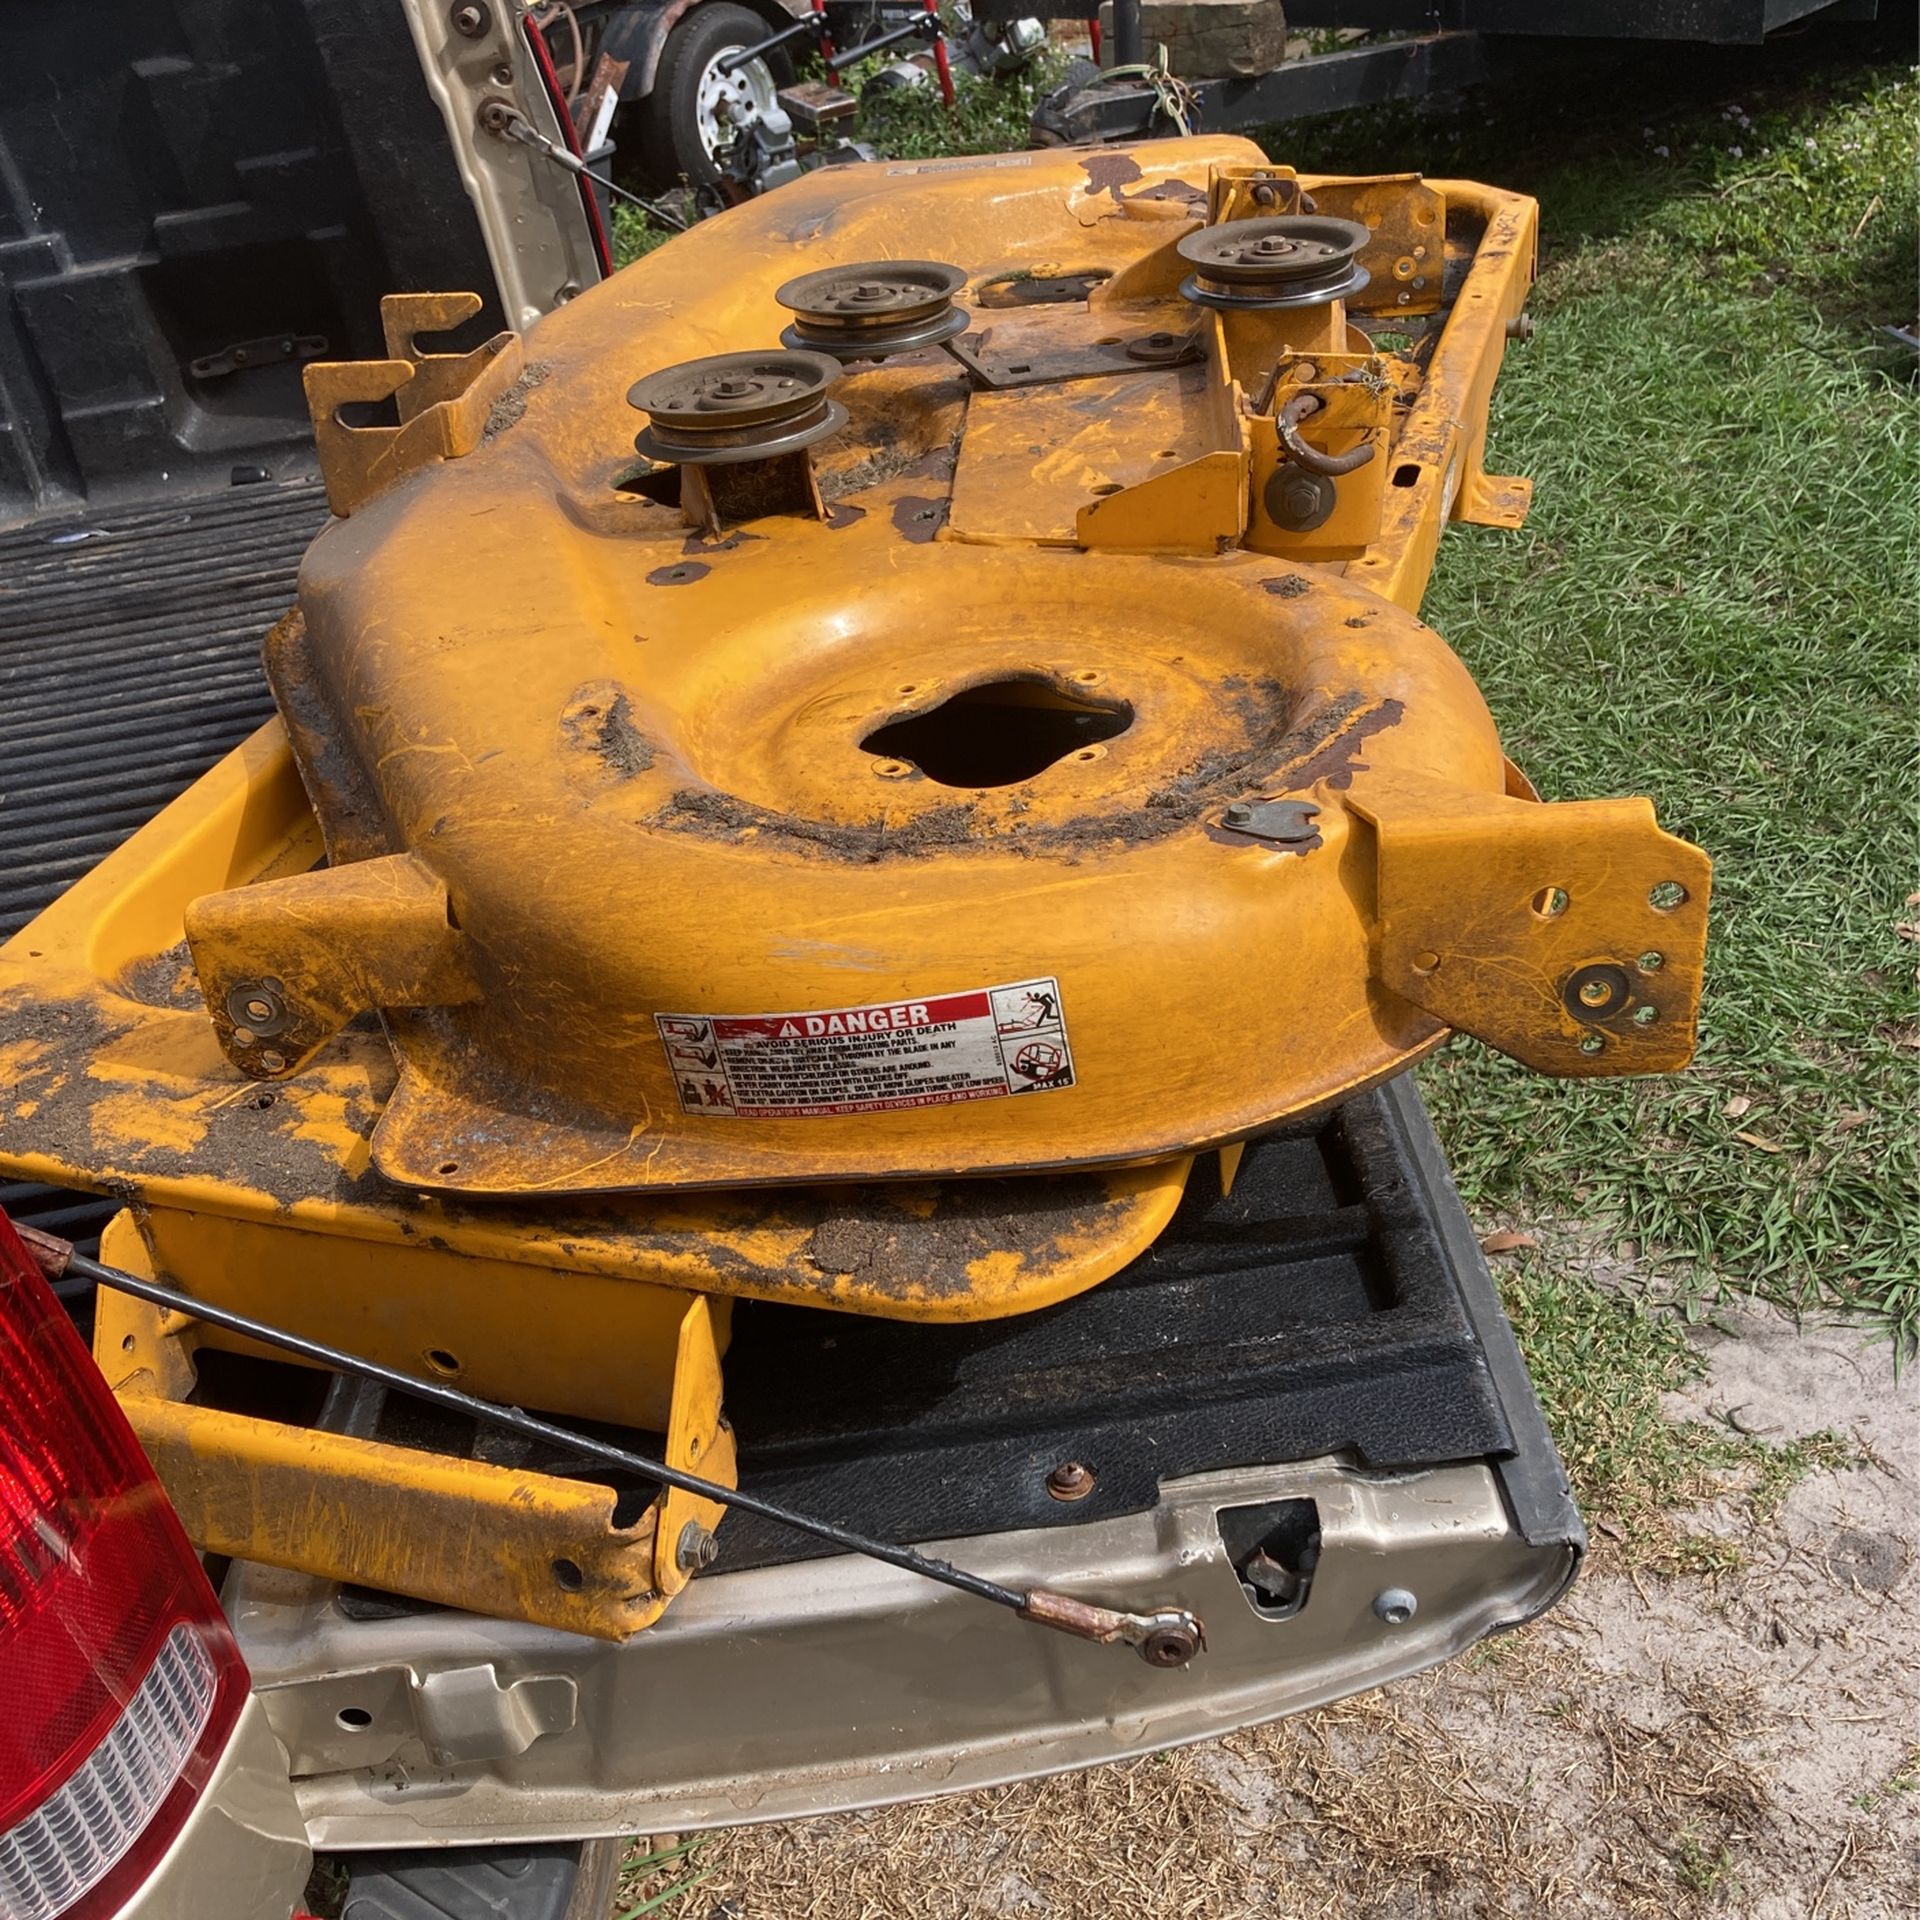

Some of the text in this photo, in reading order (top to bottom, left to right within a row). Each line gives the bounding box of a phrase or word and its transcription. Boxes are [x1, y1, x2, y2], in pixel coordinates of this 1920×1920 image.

[805, 1004, 930, 1036] DANGER
[756, 1040, 790, 1049] AVOID
[793, 1034, 845, 1048] SERIOUS
[848, 1031, 892, 1044] INJURY
[896, 1028, 914, 1038] OR
[917, 1022, 957, 1036] DEATH
[841, 1049, 874, 1060] THROWN
[875, 1048, 885, 1058] BY
[887, 1046, 903, 1056] THE
[904, 1043, 929, 1054] BLADE
[930, 1041, 939, 1051] IN
[941, 1040, 956, 1050] ANY
[853, 1040, 890, 1051] ROTATING
[891, 1037, 917, 1048] PARTS.
[801, 1070, 839, 1080] CHILDREN
[850, 1067, 881, 1077] OTHERS
[882, 1065, 897, 1074] ARE
[759, 1081, 782, 1089] CARRY
[784, 1079, 820, 1089] CHILDREN
[821, 1078, 842, 1087] EVEN
[842, 1077, 864, 1086] WITH
[905, 1077, 935, 1088] SLOPES
[1033, 1081, 1055, 1091] MAX
[856, 1101, 883, 1112] SAFETY
[885, 1098, 916, 1110] DEVICES
[927, 1093, 951, 1104] PLACE
[952, 1090, 968, 1101] AND
